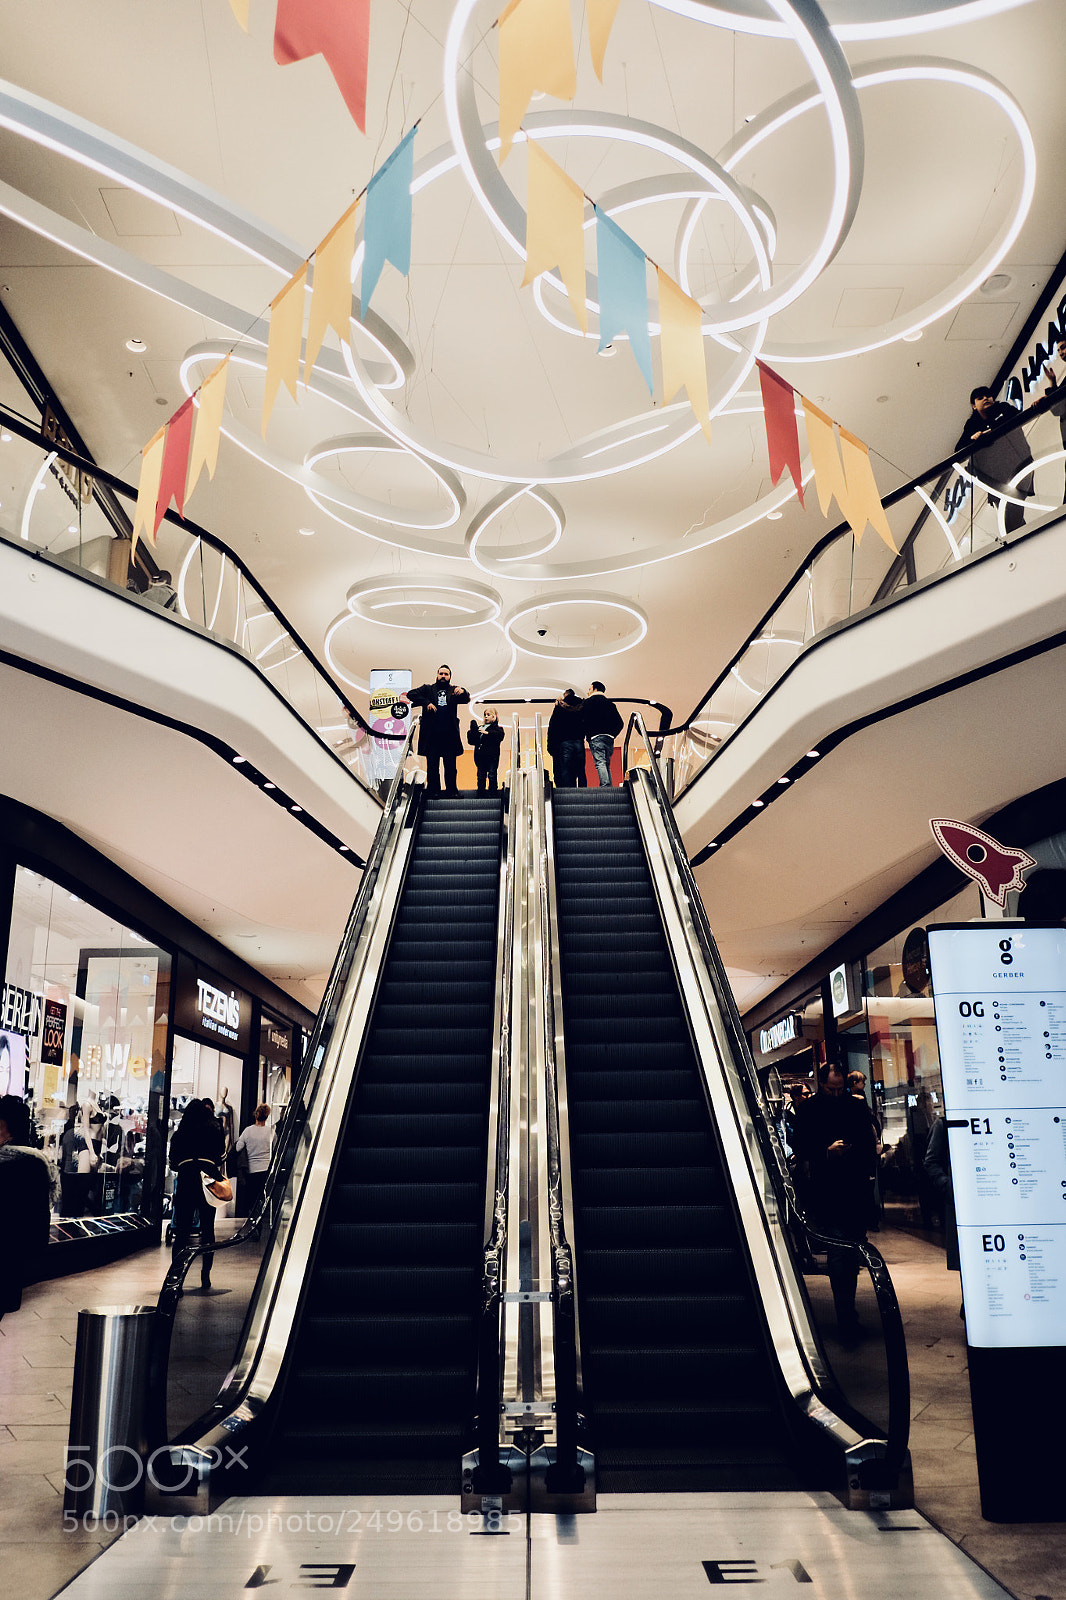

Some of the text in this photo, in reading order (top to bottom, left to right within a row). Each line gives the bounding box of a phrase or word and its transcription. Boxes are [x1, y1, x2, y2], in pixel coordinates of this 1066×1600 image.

[197, 978, 240, 1030] TEZENIS
[959, 1001, 985, 1018] OG
[45, 1015, 65, 1031] PERFECT
[44, 1029, 64, 1049] LOOK
[970, 1117, 993, 1135] E1
